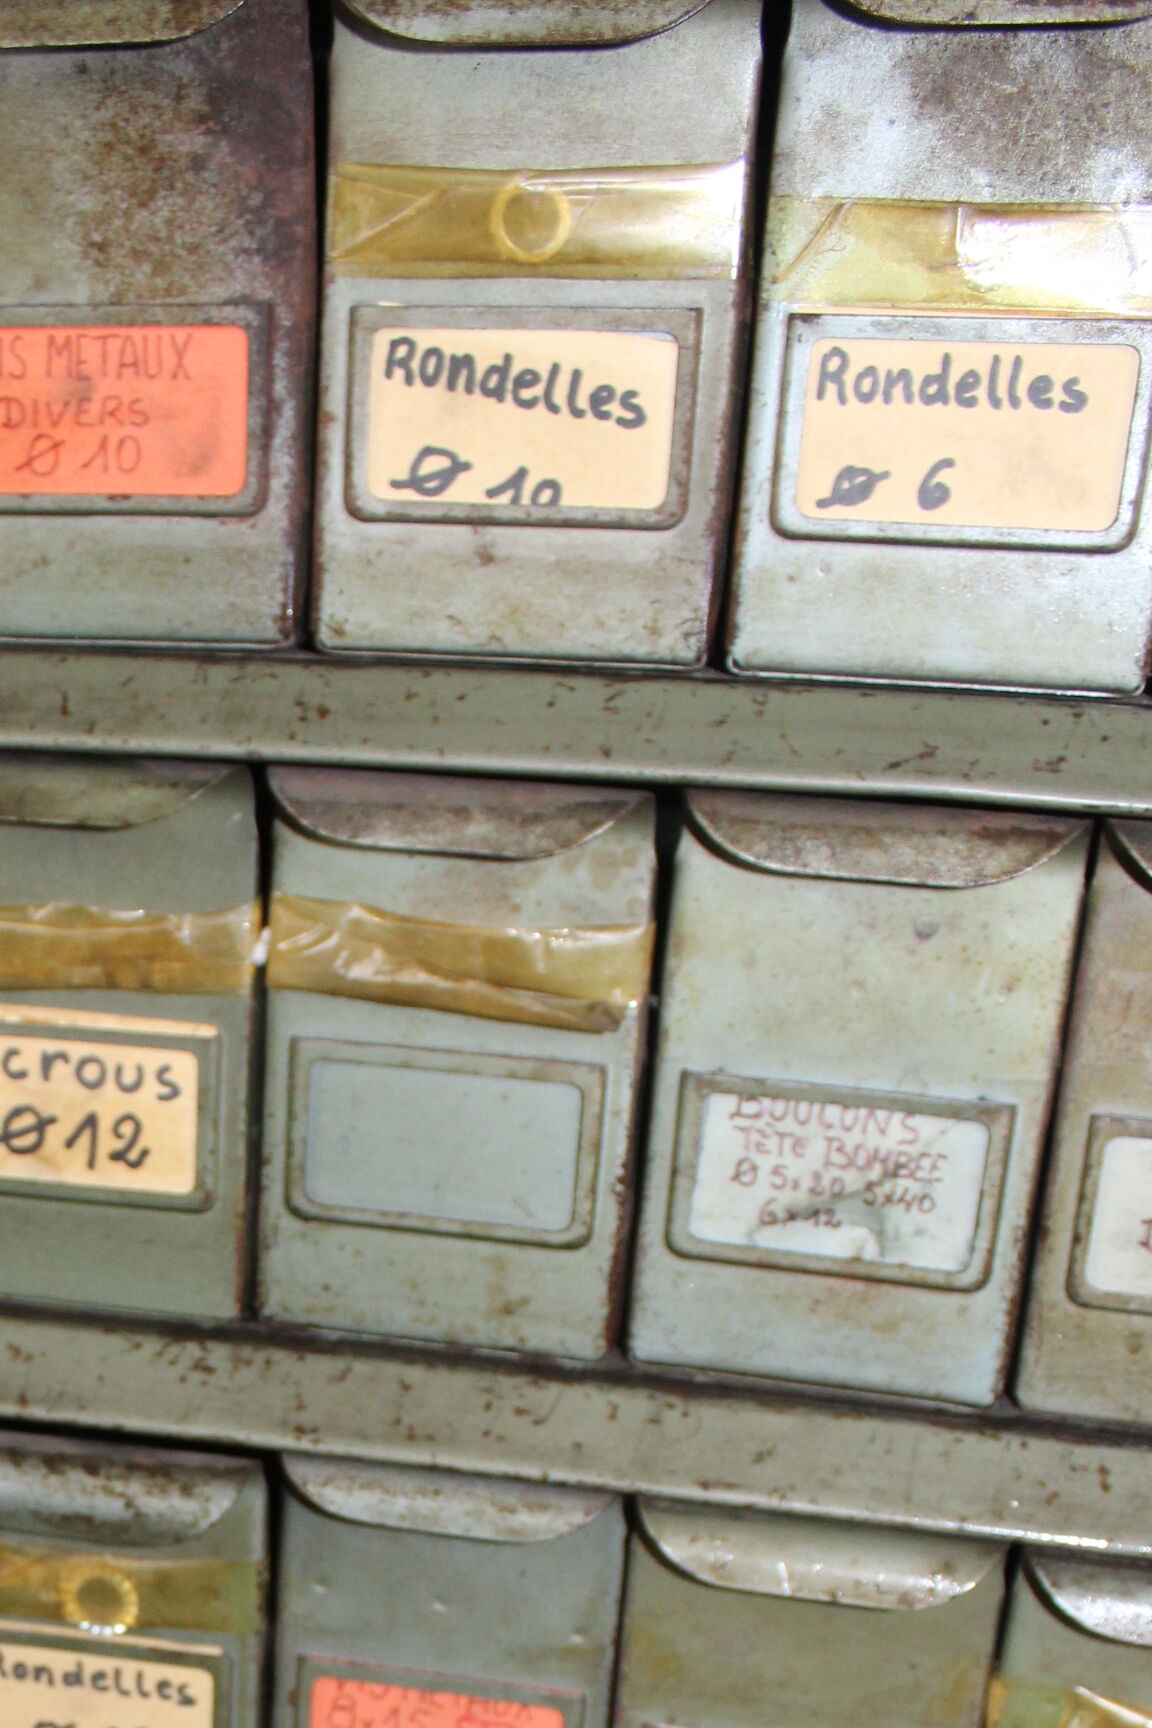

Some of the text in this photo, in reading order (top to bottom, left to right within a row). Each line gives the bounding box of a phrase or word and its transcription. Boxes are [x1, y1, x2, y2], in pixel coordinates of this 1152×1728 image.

[47, 332, 194, 382] METAUX
[384, 336, 647, 429] Rondelles
[816, 346, 1089, 414] Rondelles
[79, 434, 142, 474] 10
[485, 466, 563, 506] 10
[917, 457, 957, 511] 6
